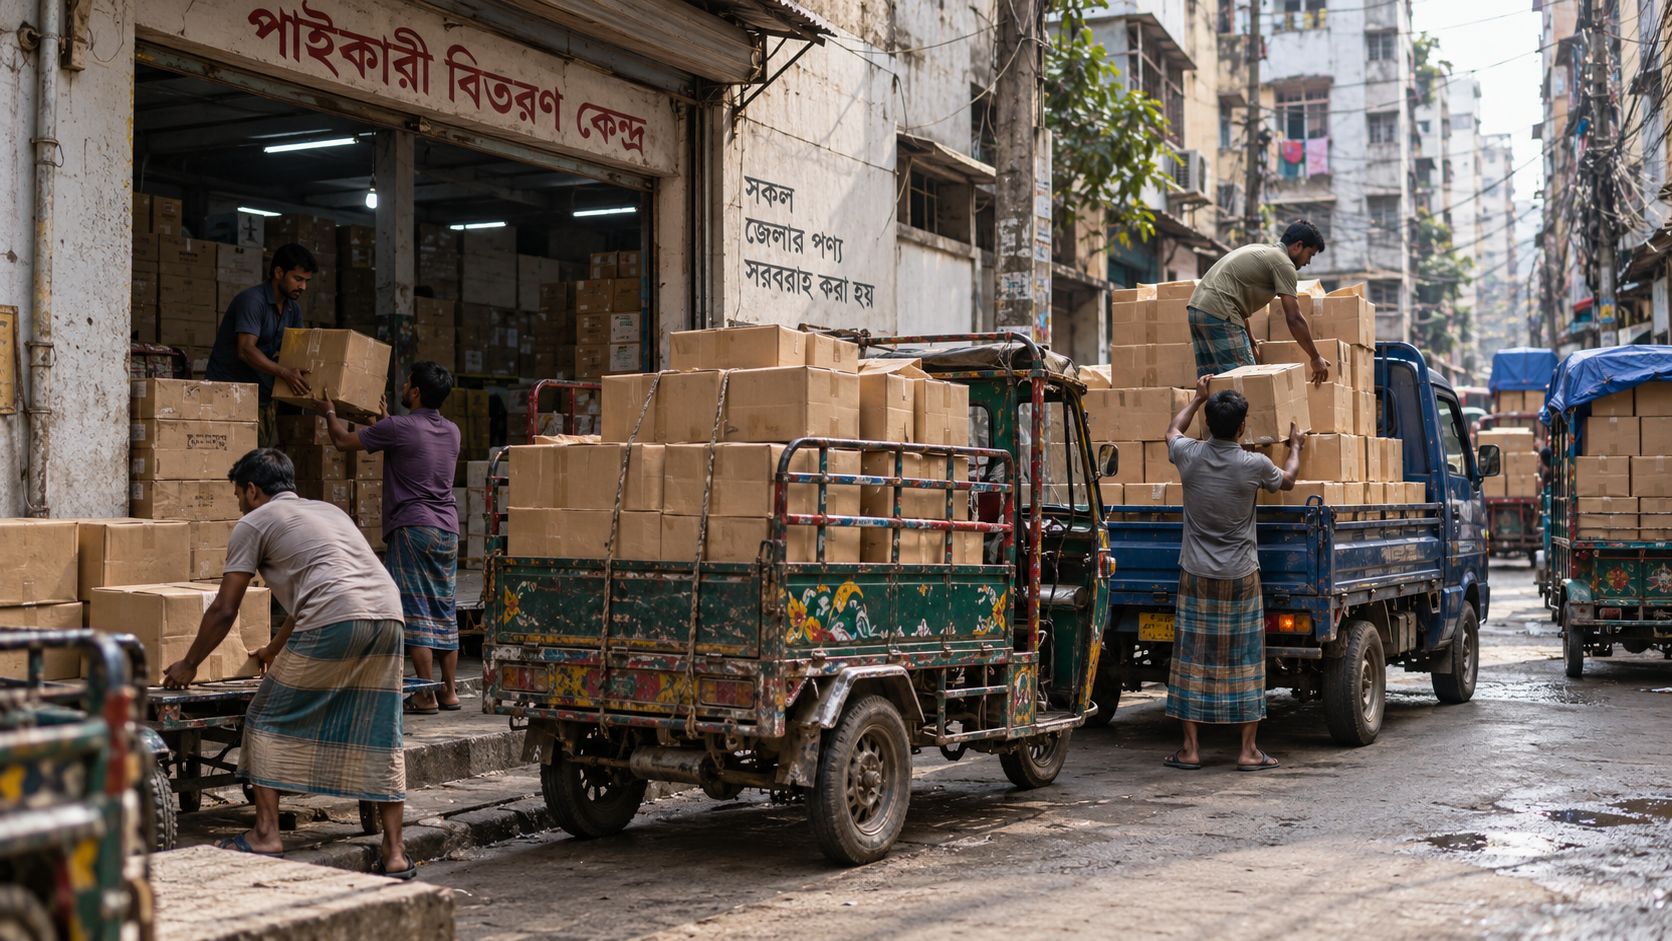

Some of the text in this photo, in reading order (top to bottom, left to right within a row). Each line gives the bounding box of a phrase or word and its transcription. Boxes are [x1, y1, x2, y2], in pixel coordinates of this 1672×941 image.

[248, 0, 647, 155] পাইকারী বিতরণ কেন্দ্র
[744, 175, 795, 214] সকল
[745, 217, 843, 264] জেলার পণ্য
[744, 259, 875, 309] সরবরাহ করা হয়
